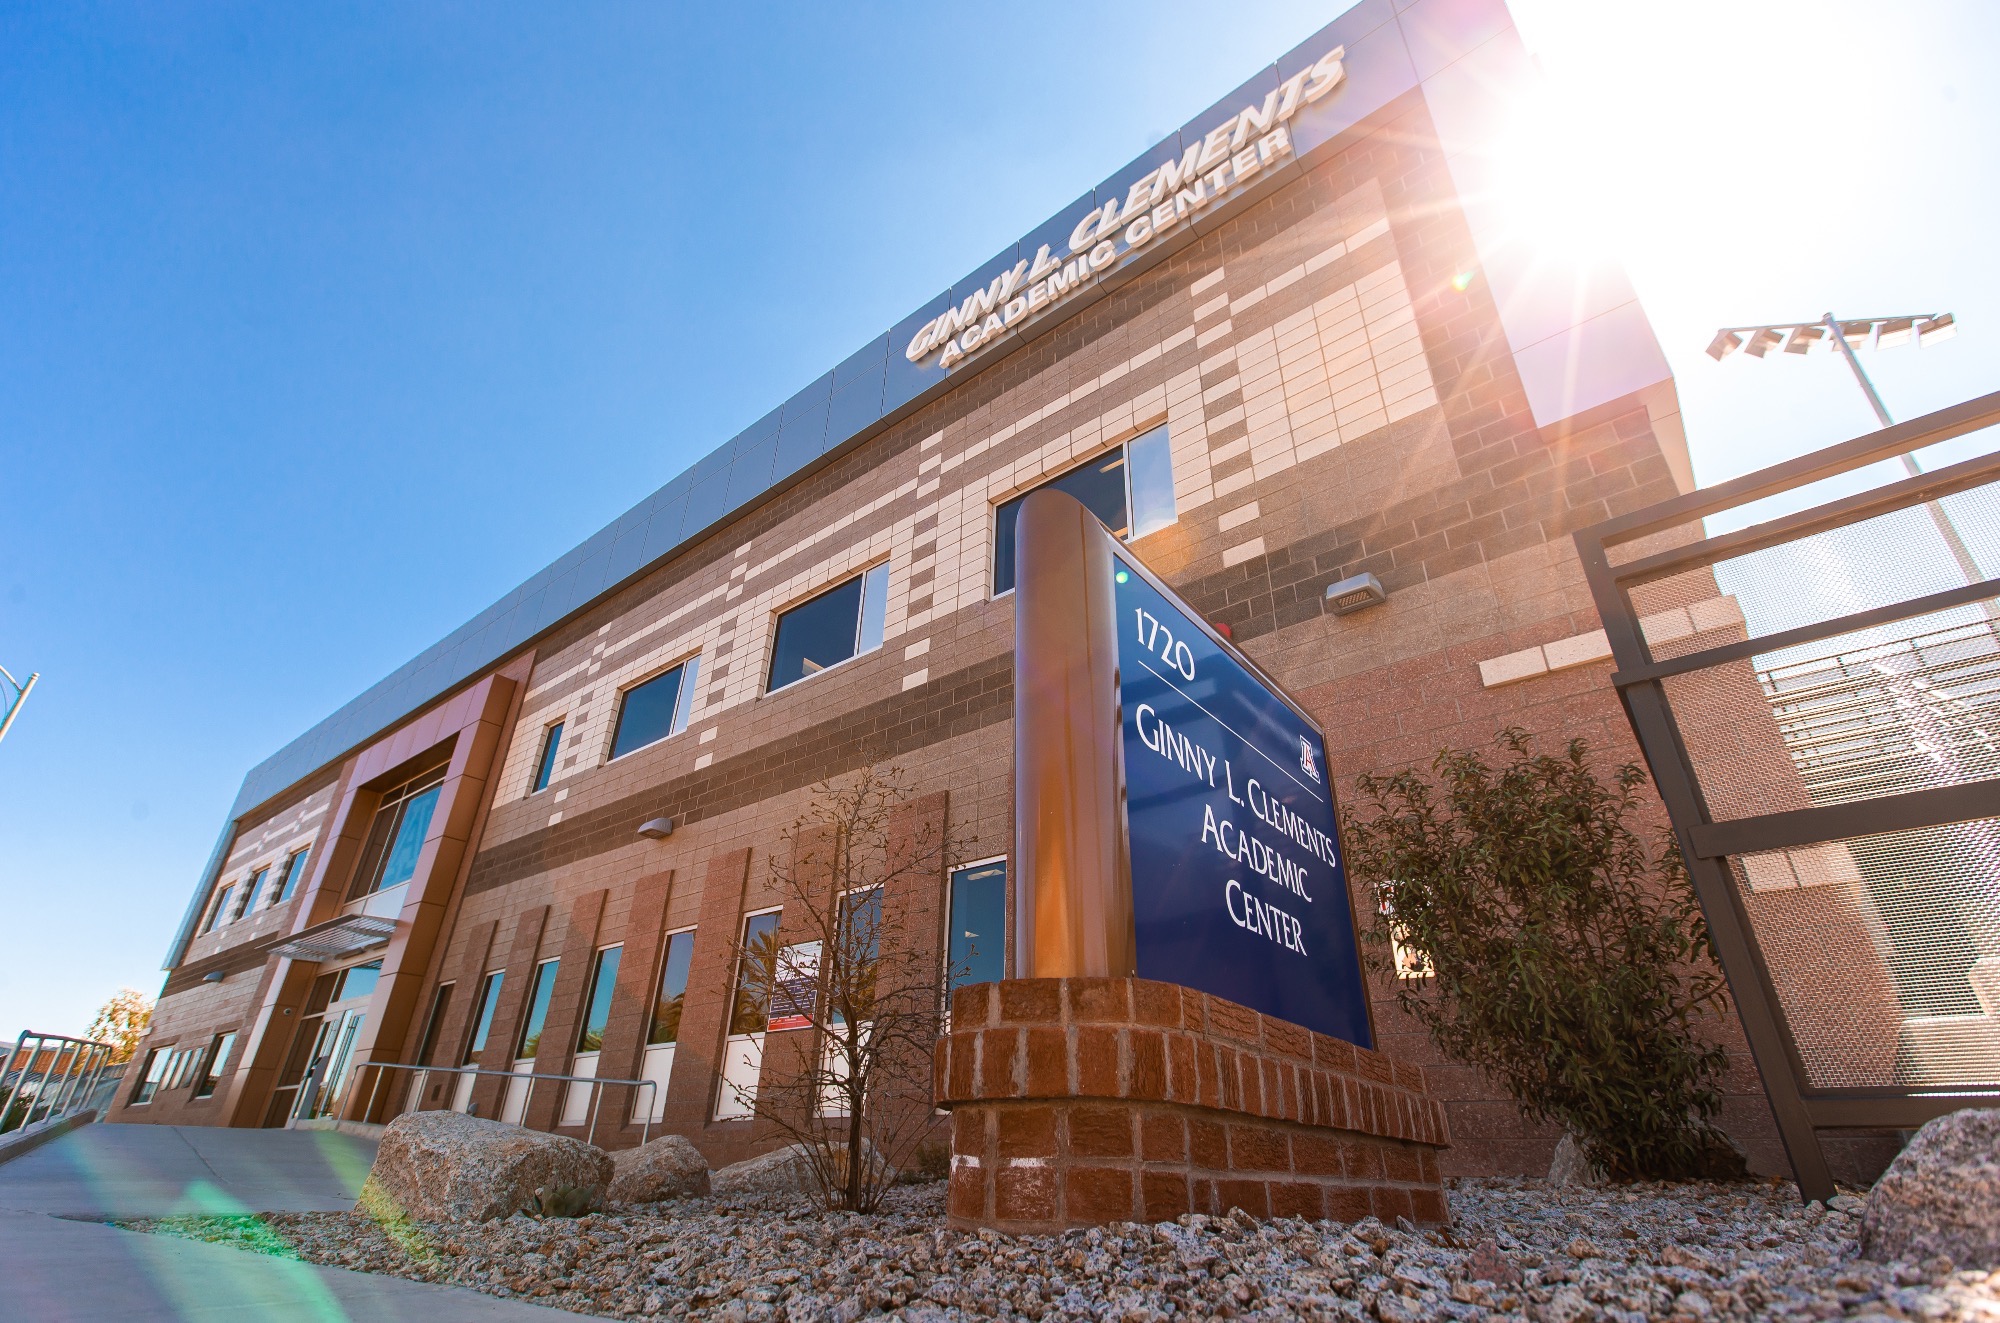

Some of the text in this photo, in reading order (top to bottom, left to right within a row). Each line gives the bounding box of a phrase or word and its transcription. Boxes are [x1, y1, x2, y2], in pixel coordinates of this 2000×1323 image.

[906, 44, 1347, 362] GINNY L. CLEMENTS
[939, 126, 1293, 368] ACADEMIC CENTER
[1135, 608, 1196, 681] 1720
[1135, 703, 1337, 868] GINNY L. CLEMENTS
[1201, 803, 1313, 903] ACADEMIC
[1225, 879, 1308, 957] CENTER
